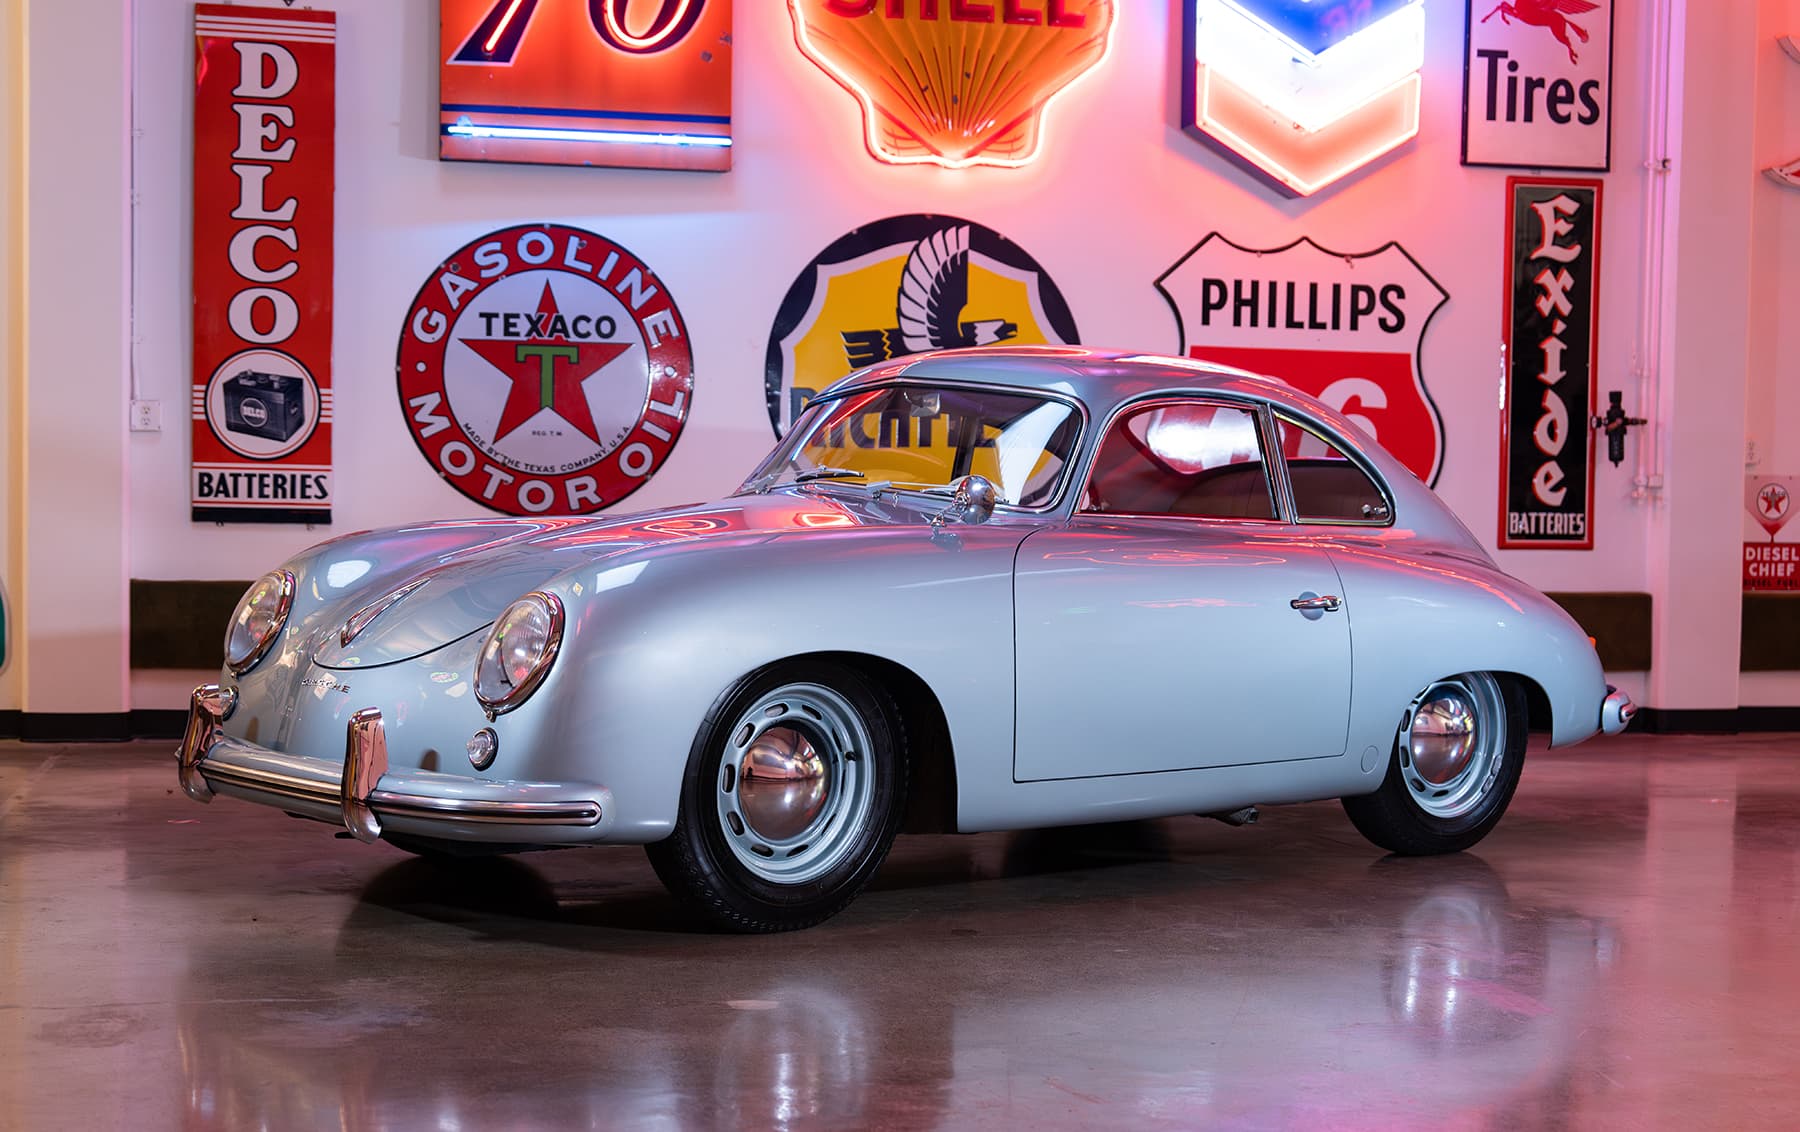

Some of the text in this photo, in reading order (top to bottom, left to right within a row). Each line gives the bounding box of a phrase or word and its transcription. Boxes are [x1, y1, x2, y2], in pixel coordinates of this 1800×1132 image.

[1477, 48, 1600, 125] Tires
[227, 41, 299, 344] DELCO
[411, 230, 681, 349] GASOLINE
[1201, 277, 1406, 334] PHILLIPS
[478, 312, 617, 339] TEXACO
[1530, 192, 1582, 507] Exide
[515, 344, 579, 410] T
[408, 390, 685, 513] MOTOR OIL
[463, 423, 486, 448] MADE
[524, 463, 556, 473] TEXAS
[198, 472, 329, 500] BATTERIES
[1509, 512, 1584, 535] BATTERIES
[1745, 546, 1800, 561] DIESEL
[1748, 562, 1795, 577] CHIEF
